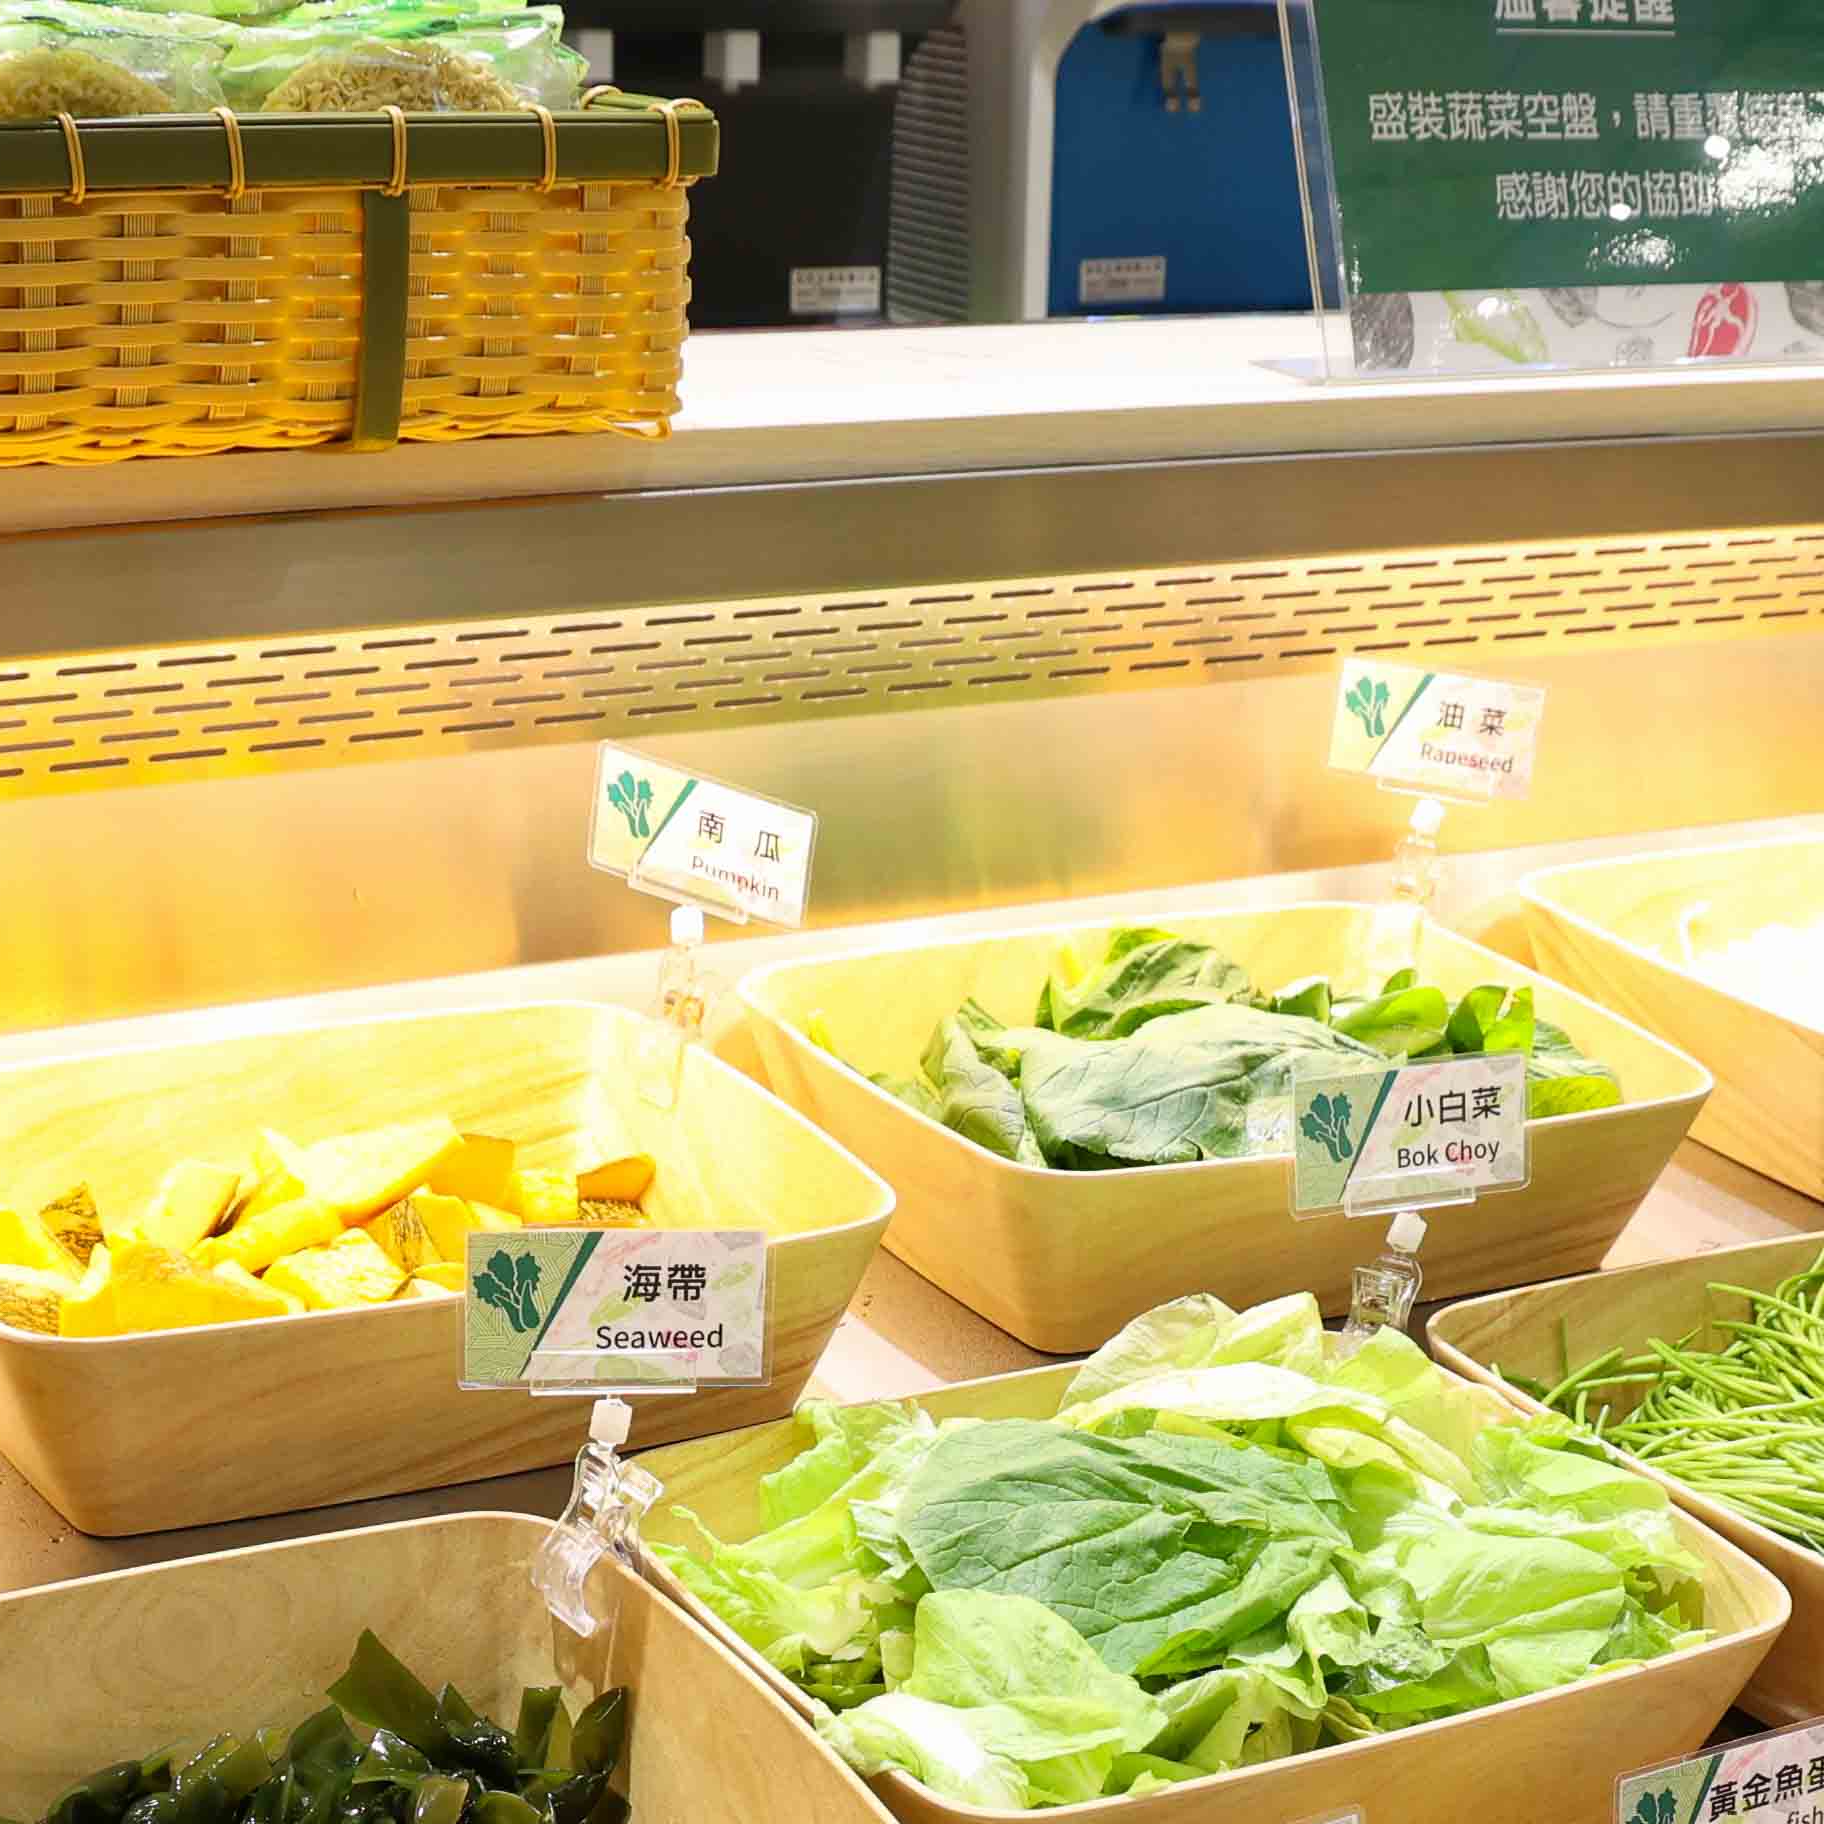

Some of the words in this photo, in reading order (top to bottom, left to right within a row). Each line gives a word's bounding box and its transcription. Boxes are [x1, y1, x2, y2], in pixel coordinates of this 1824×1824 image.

[1435, 700, 1508, 737] 油菜
[1420, 742, 1515, 774] Rapeseed
[697, 809, 783, 864] 南瓜
[1403, 1085, 1503, 1128] 小白菜
[1397, 1144, 1440, 1169] Bok
[1444, 1138, 1501, 1164] Choy
[622, 1263, 707, 1303] 海帶
[595, 1323, 725, 1350] Seaweed
